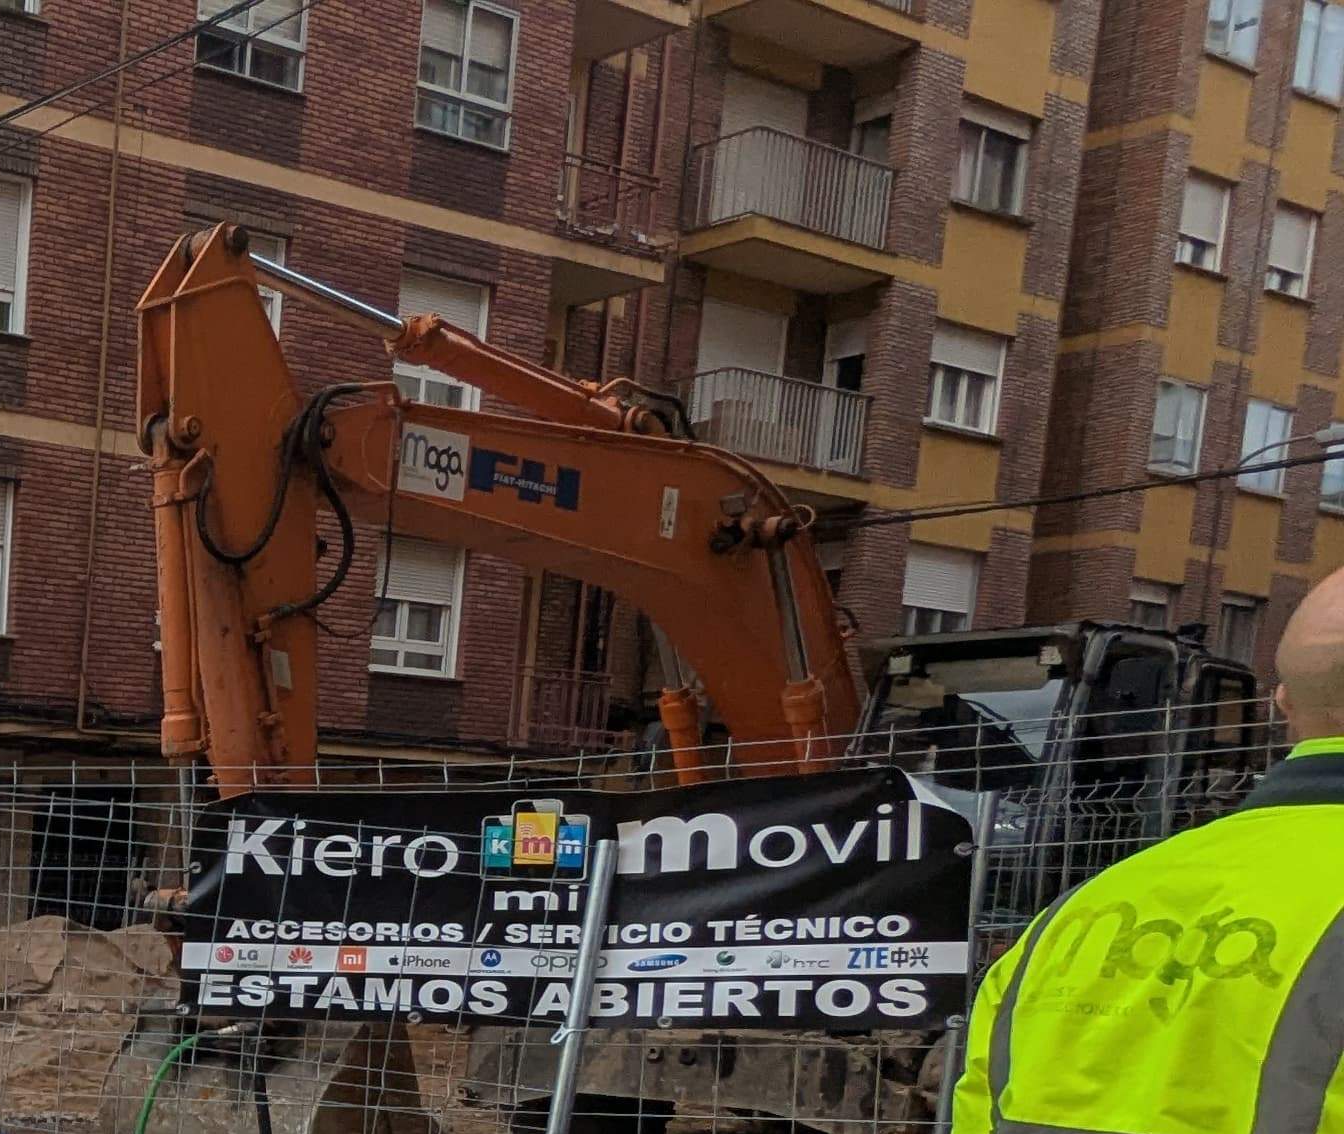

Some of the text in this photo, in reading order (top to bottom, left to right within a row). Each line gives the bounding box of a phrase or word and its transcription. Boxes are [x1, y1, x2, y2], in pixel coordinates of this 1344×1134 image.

[493, 472, 557, 496] FIAT-HITACHI
[224, 818, 460, 878] Kiero
[493, 885, 580, 912] mi
[225, 919, 465, 943] ACCESORIOS
[504, 921, 693, 944] SERICIO
[706, 913, 912, 942] TÉCNICO
[238, 948, 258, 961] LG
[402, 955, 451, 969] iPhone
[633, 958, 681, 968] SAMSUNG
[847, 946, 889, 969] ZTE
[197, 973, 929, 1018] ESTAMOS ABIERTOS
